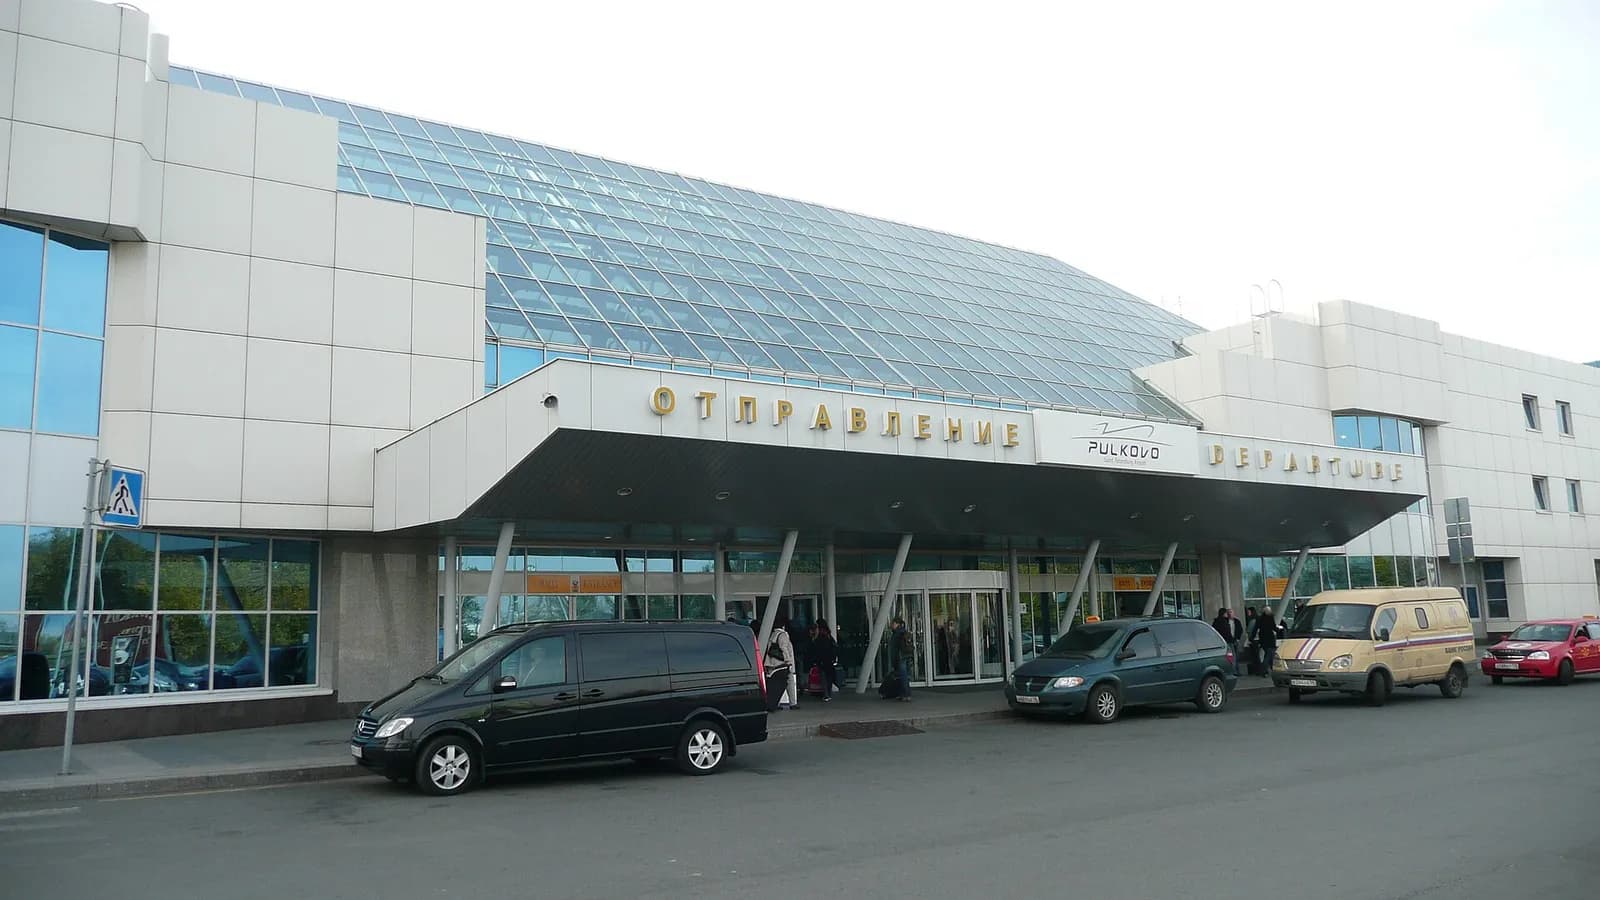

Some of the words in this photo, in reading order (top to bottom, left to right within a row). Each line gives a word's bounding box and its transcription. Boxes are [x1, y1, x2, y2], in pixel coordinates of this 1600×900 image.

[650, 386, 1020, 447] ОТПРАВЛЕНИЕ
[1088, 441, 1160, 460] PULKOVO
[1208, 443, 1403, 482] DEPARTURE
